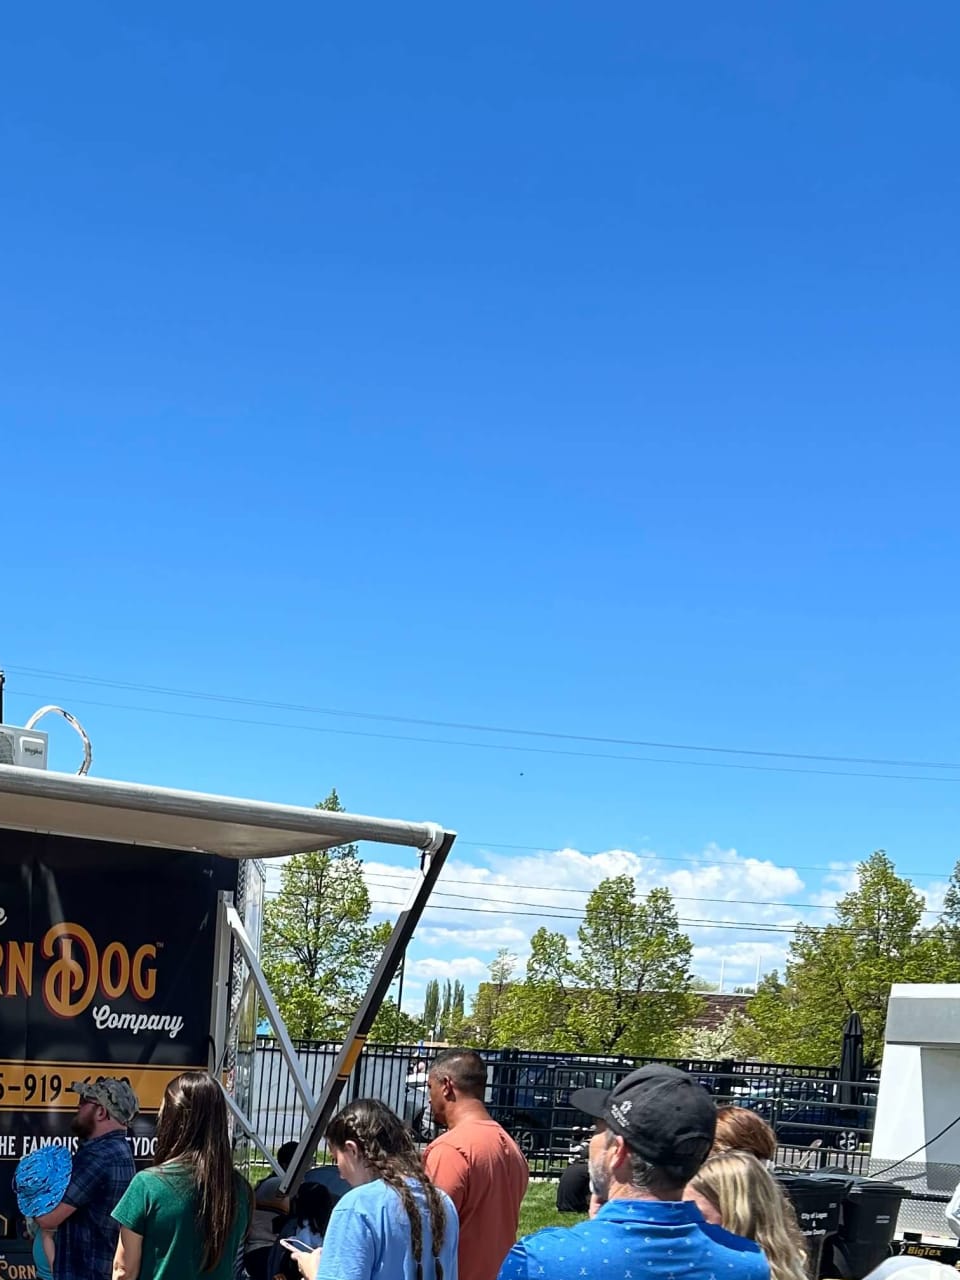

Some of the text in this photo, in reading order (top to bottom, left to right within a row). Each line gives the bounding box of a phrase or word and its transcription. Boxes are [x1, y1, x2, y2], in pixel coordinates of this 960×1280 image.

[42, 921, 157, 1018] DOG
[92, 1004, 184, 1039] Company
[907, 1246, 942, 1257] BigTex
